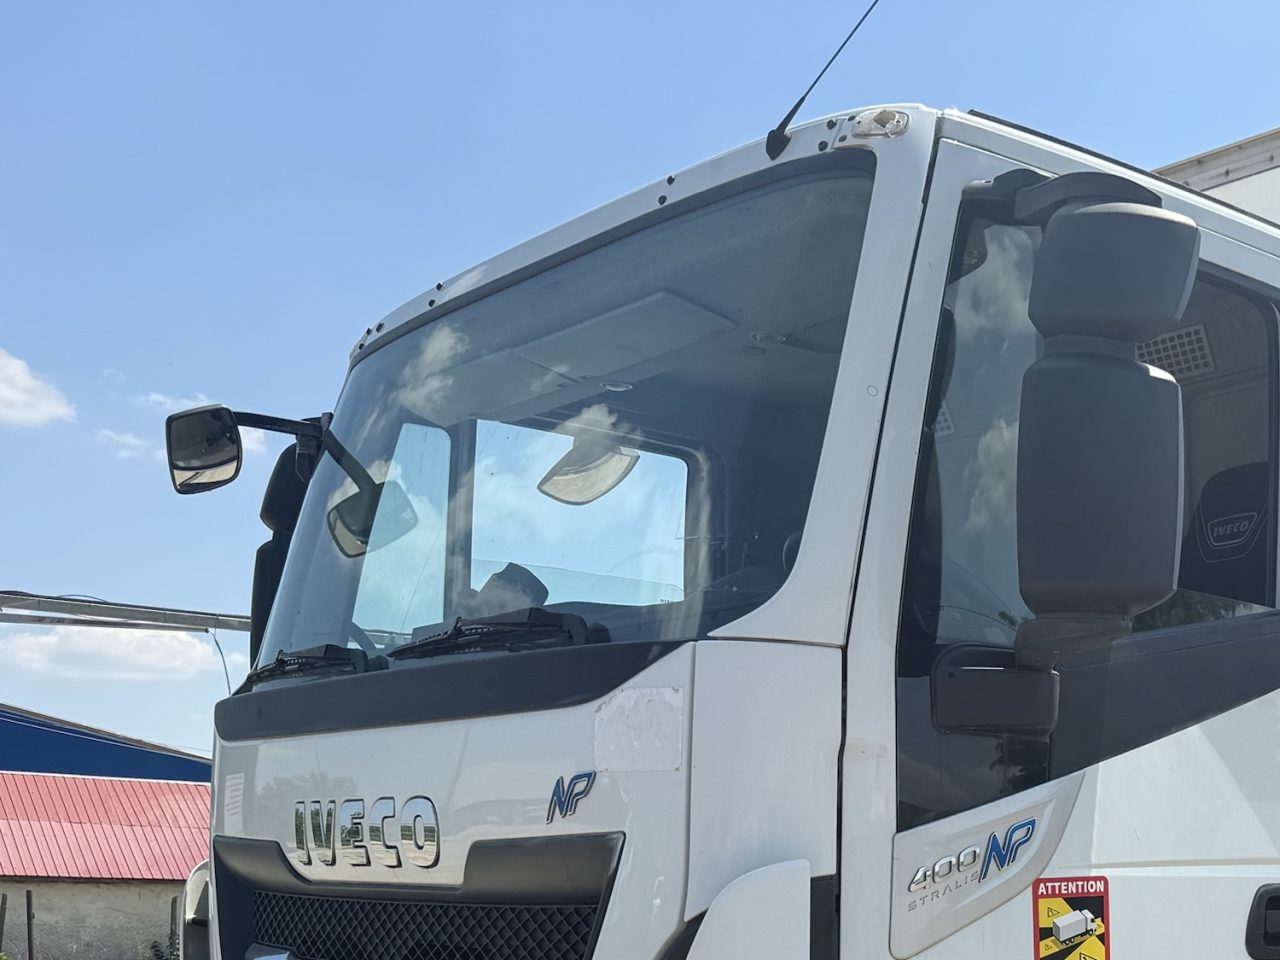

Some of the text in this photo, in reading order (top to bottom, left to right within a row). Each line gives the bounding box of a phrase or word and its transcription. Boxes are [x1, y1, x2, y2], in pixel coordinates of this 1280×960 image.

[1213, 520, 1250, 537] IVECO
[545, 769, 598, 825] NP
[293, 794, 441, 869] IVECO
[908, 816, 1038, 893] 400 NP
[907, 870, 980, 912] STRALIS
[1038, 880, 1105, 896] ATTENTION
